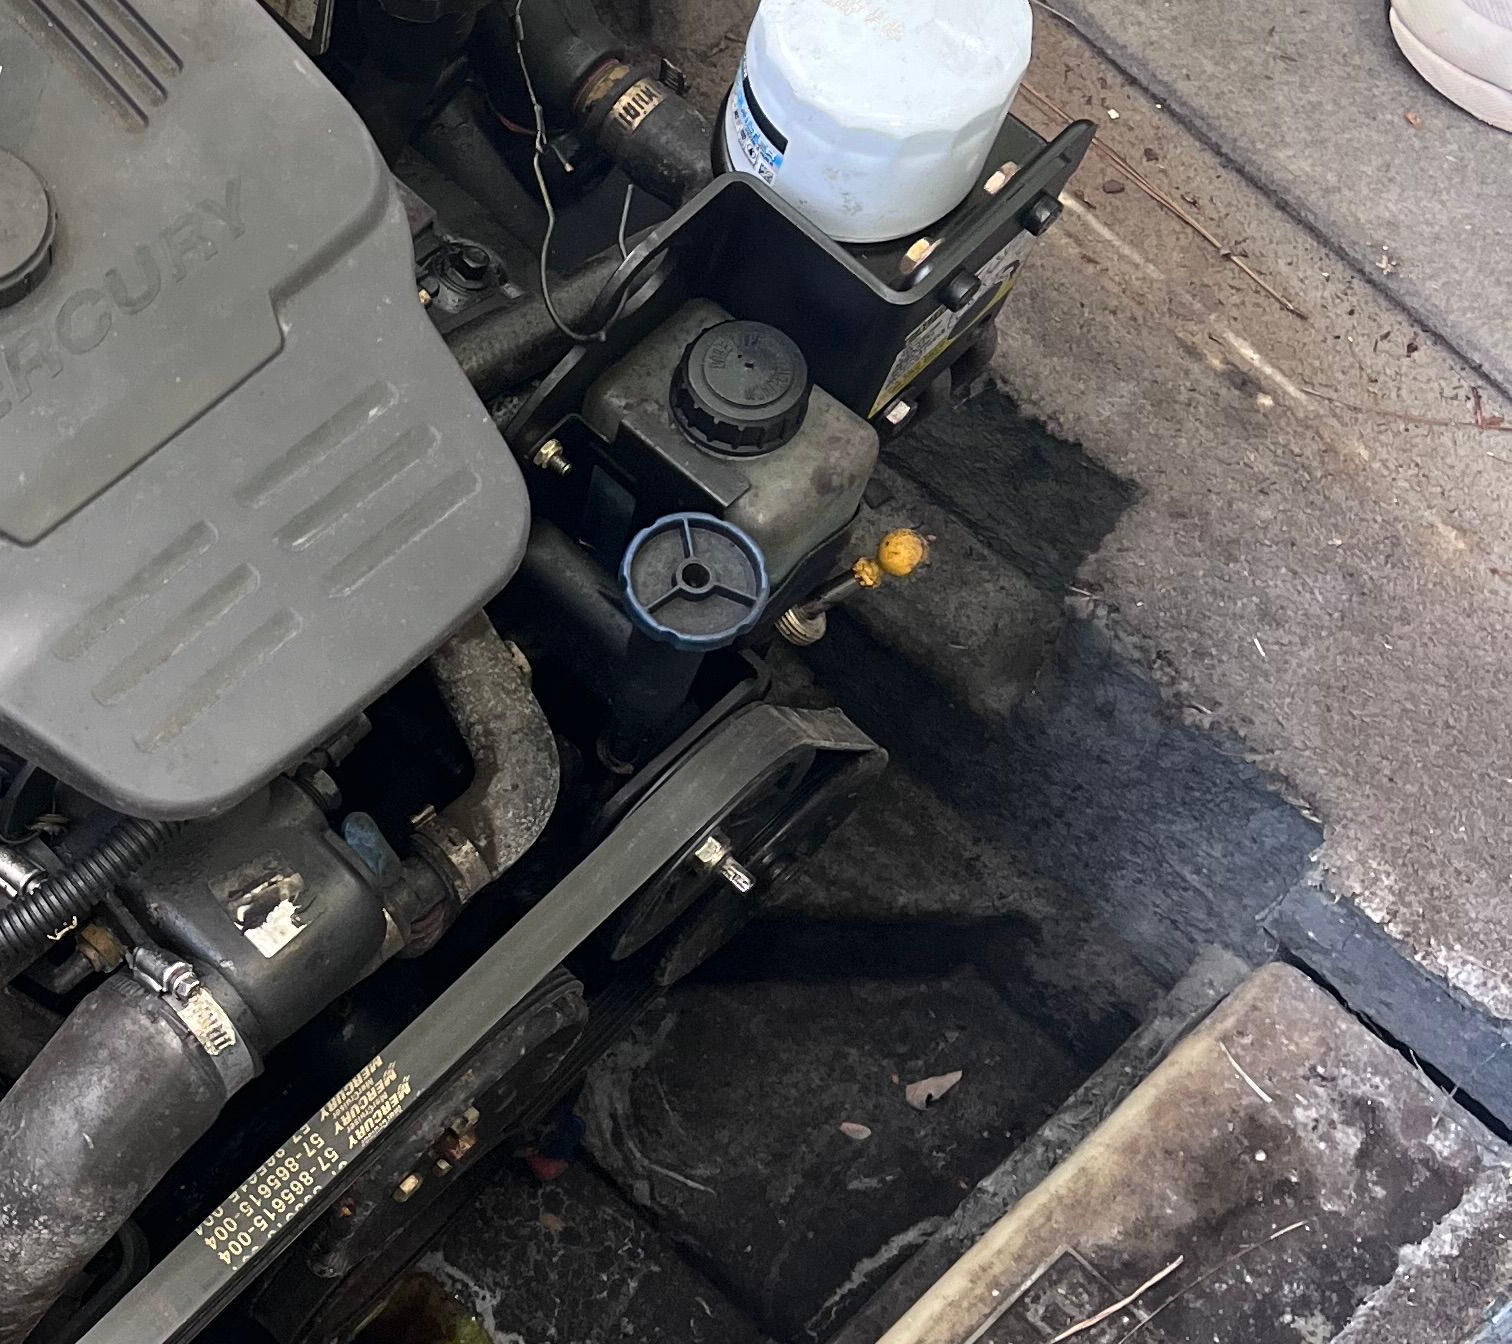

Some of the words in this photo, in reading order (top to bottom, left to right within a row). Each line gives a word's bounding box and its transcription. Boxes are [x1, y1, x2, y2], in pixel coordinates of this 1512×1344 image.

[320, 1055, 384, 1122] MERCURY
[335, 1061, 398, 1136] MERCURY
[349, 1075, 412, 1149] MERCURY
[204, 1133, 325, 1250] 57-865615-004
[218, 1147, 340, 1265] 57-865615-004
